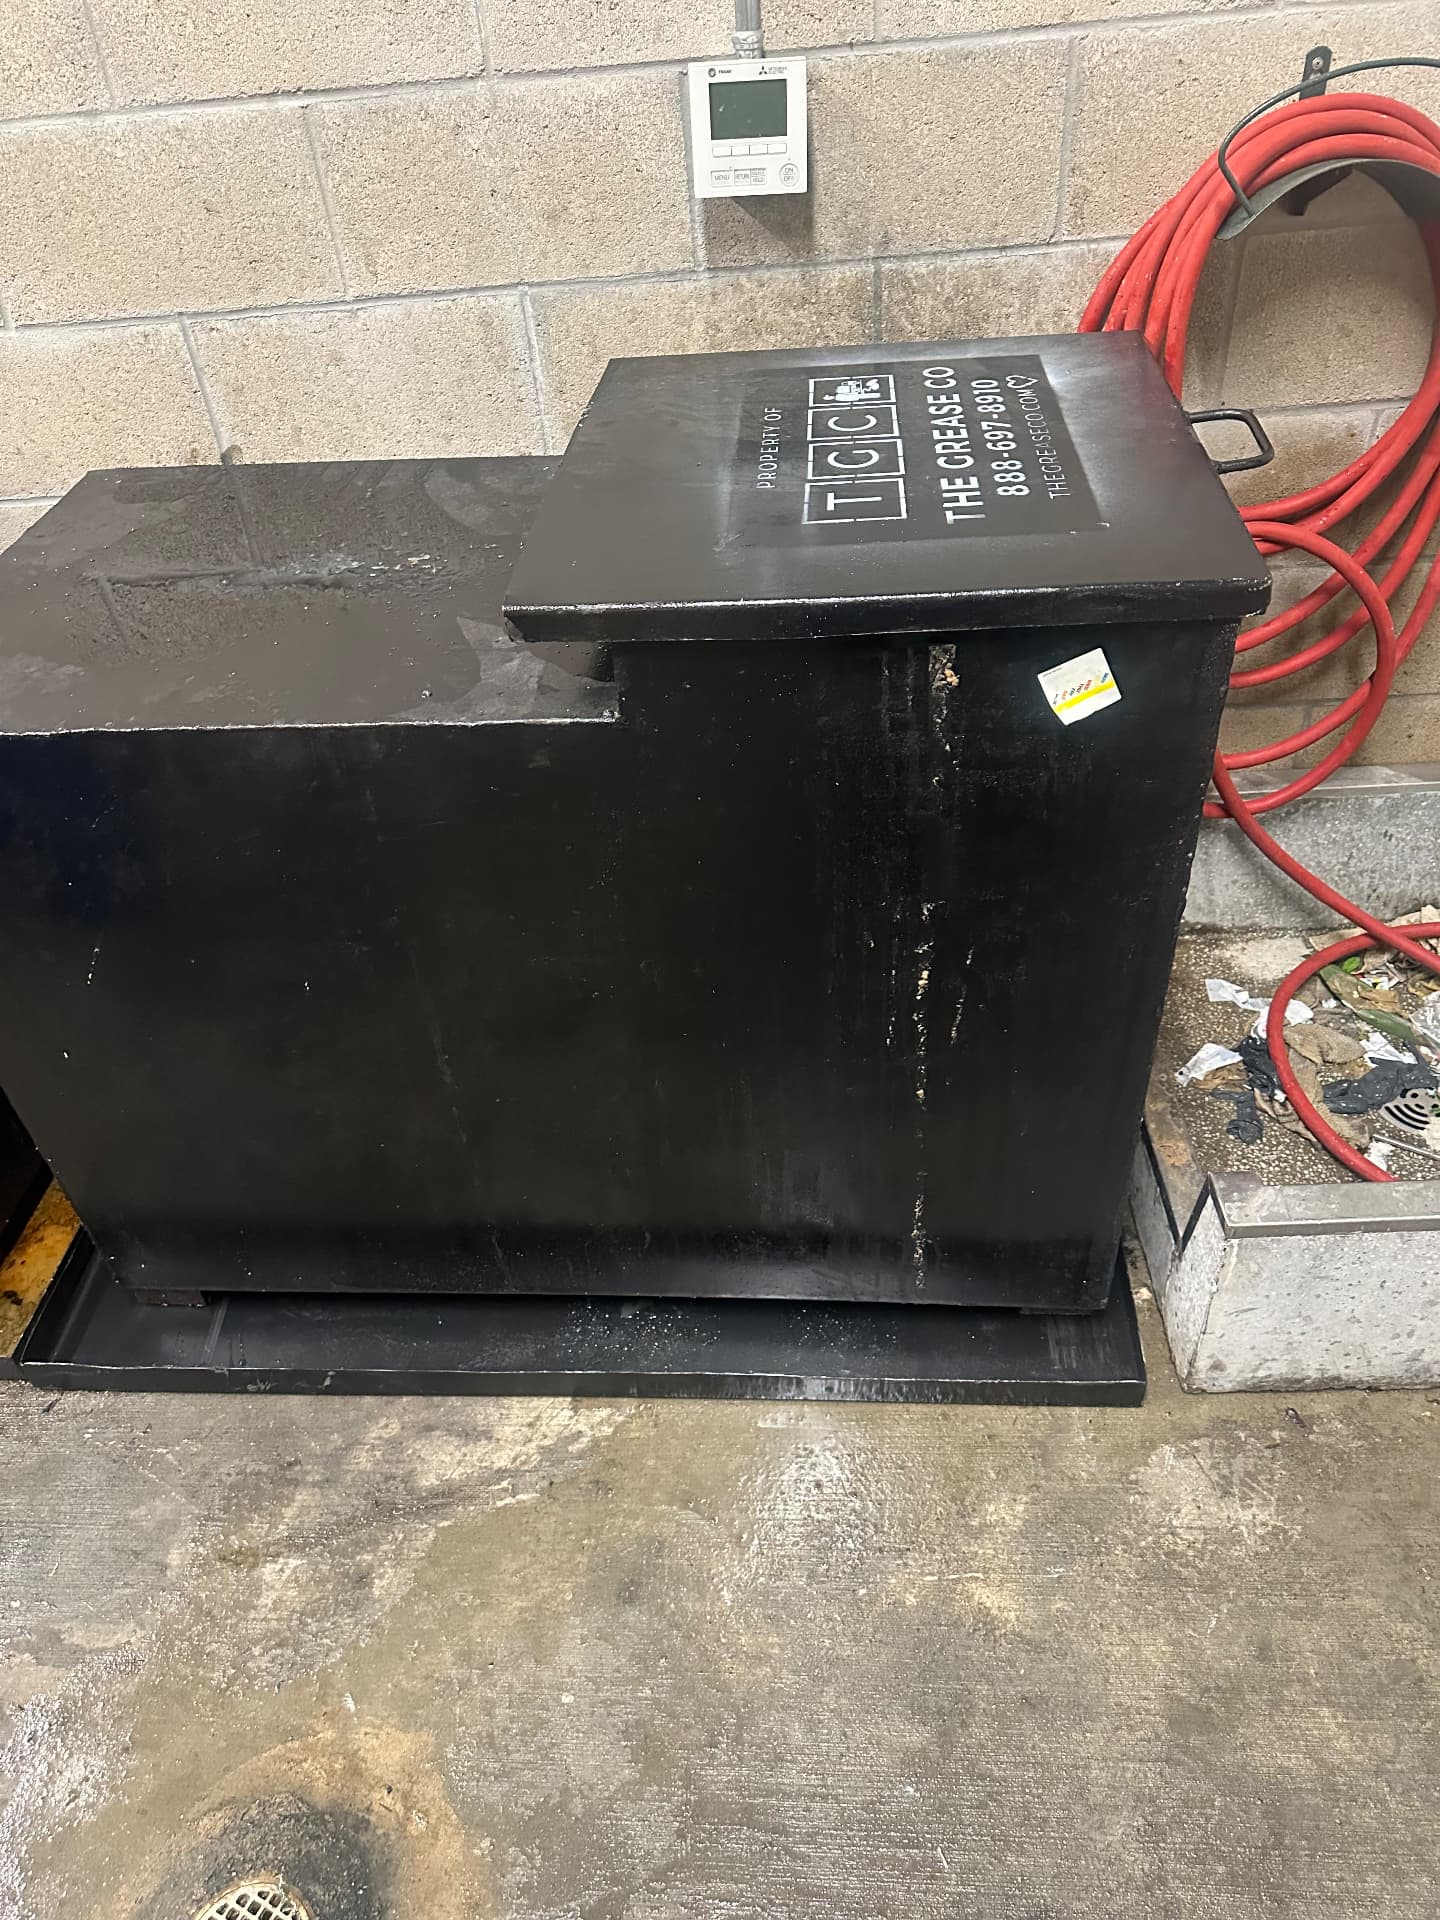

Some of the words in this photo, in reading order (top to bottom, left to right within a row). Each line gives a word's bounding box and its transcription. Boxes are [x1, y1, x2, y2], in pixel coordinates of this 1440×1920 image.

[922, 366, 957, 389] CO
[764, 407, 782, 423] OF
[927, 393, 975, 469] GREASE
[970, 379, 1030, 497] 888-697-8910
[756, 431, 781, 489] PROPERTY
[1015, 389, 1071, 500] THEGREASECO.COM
[942, 476, 986, 524] THE
